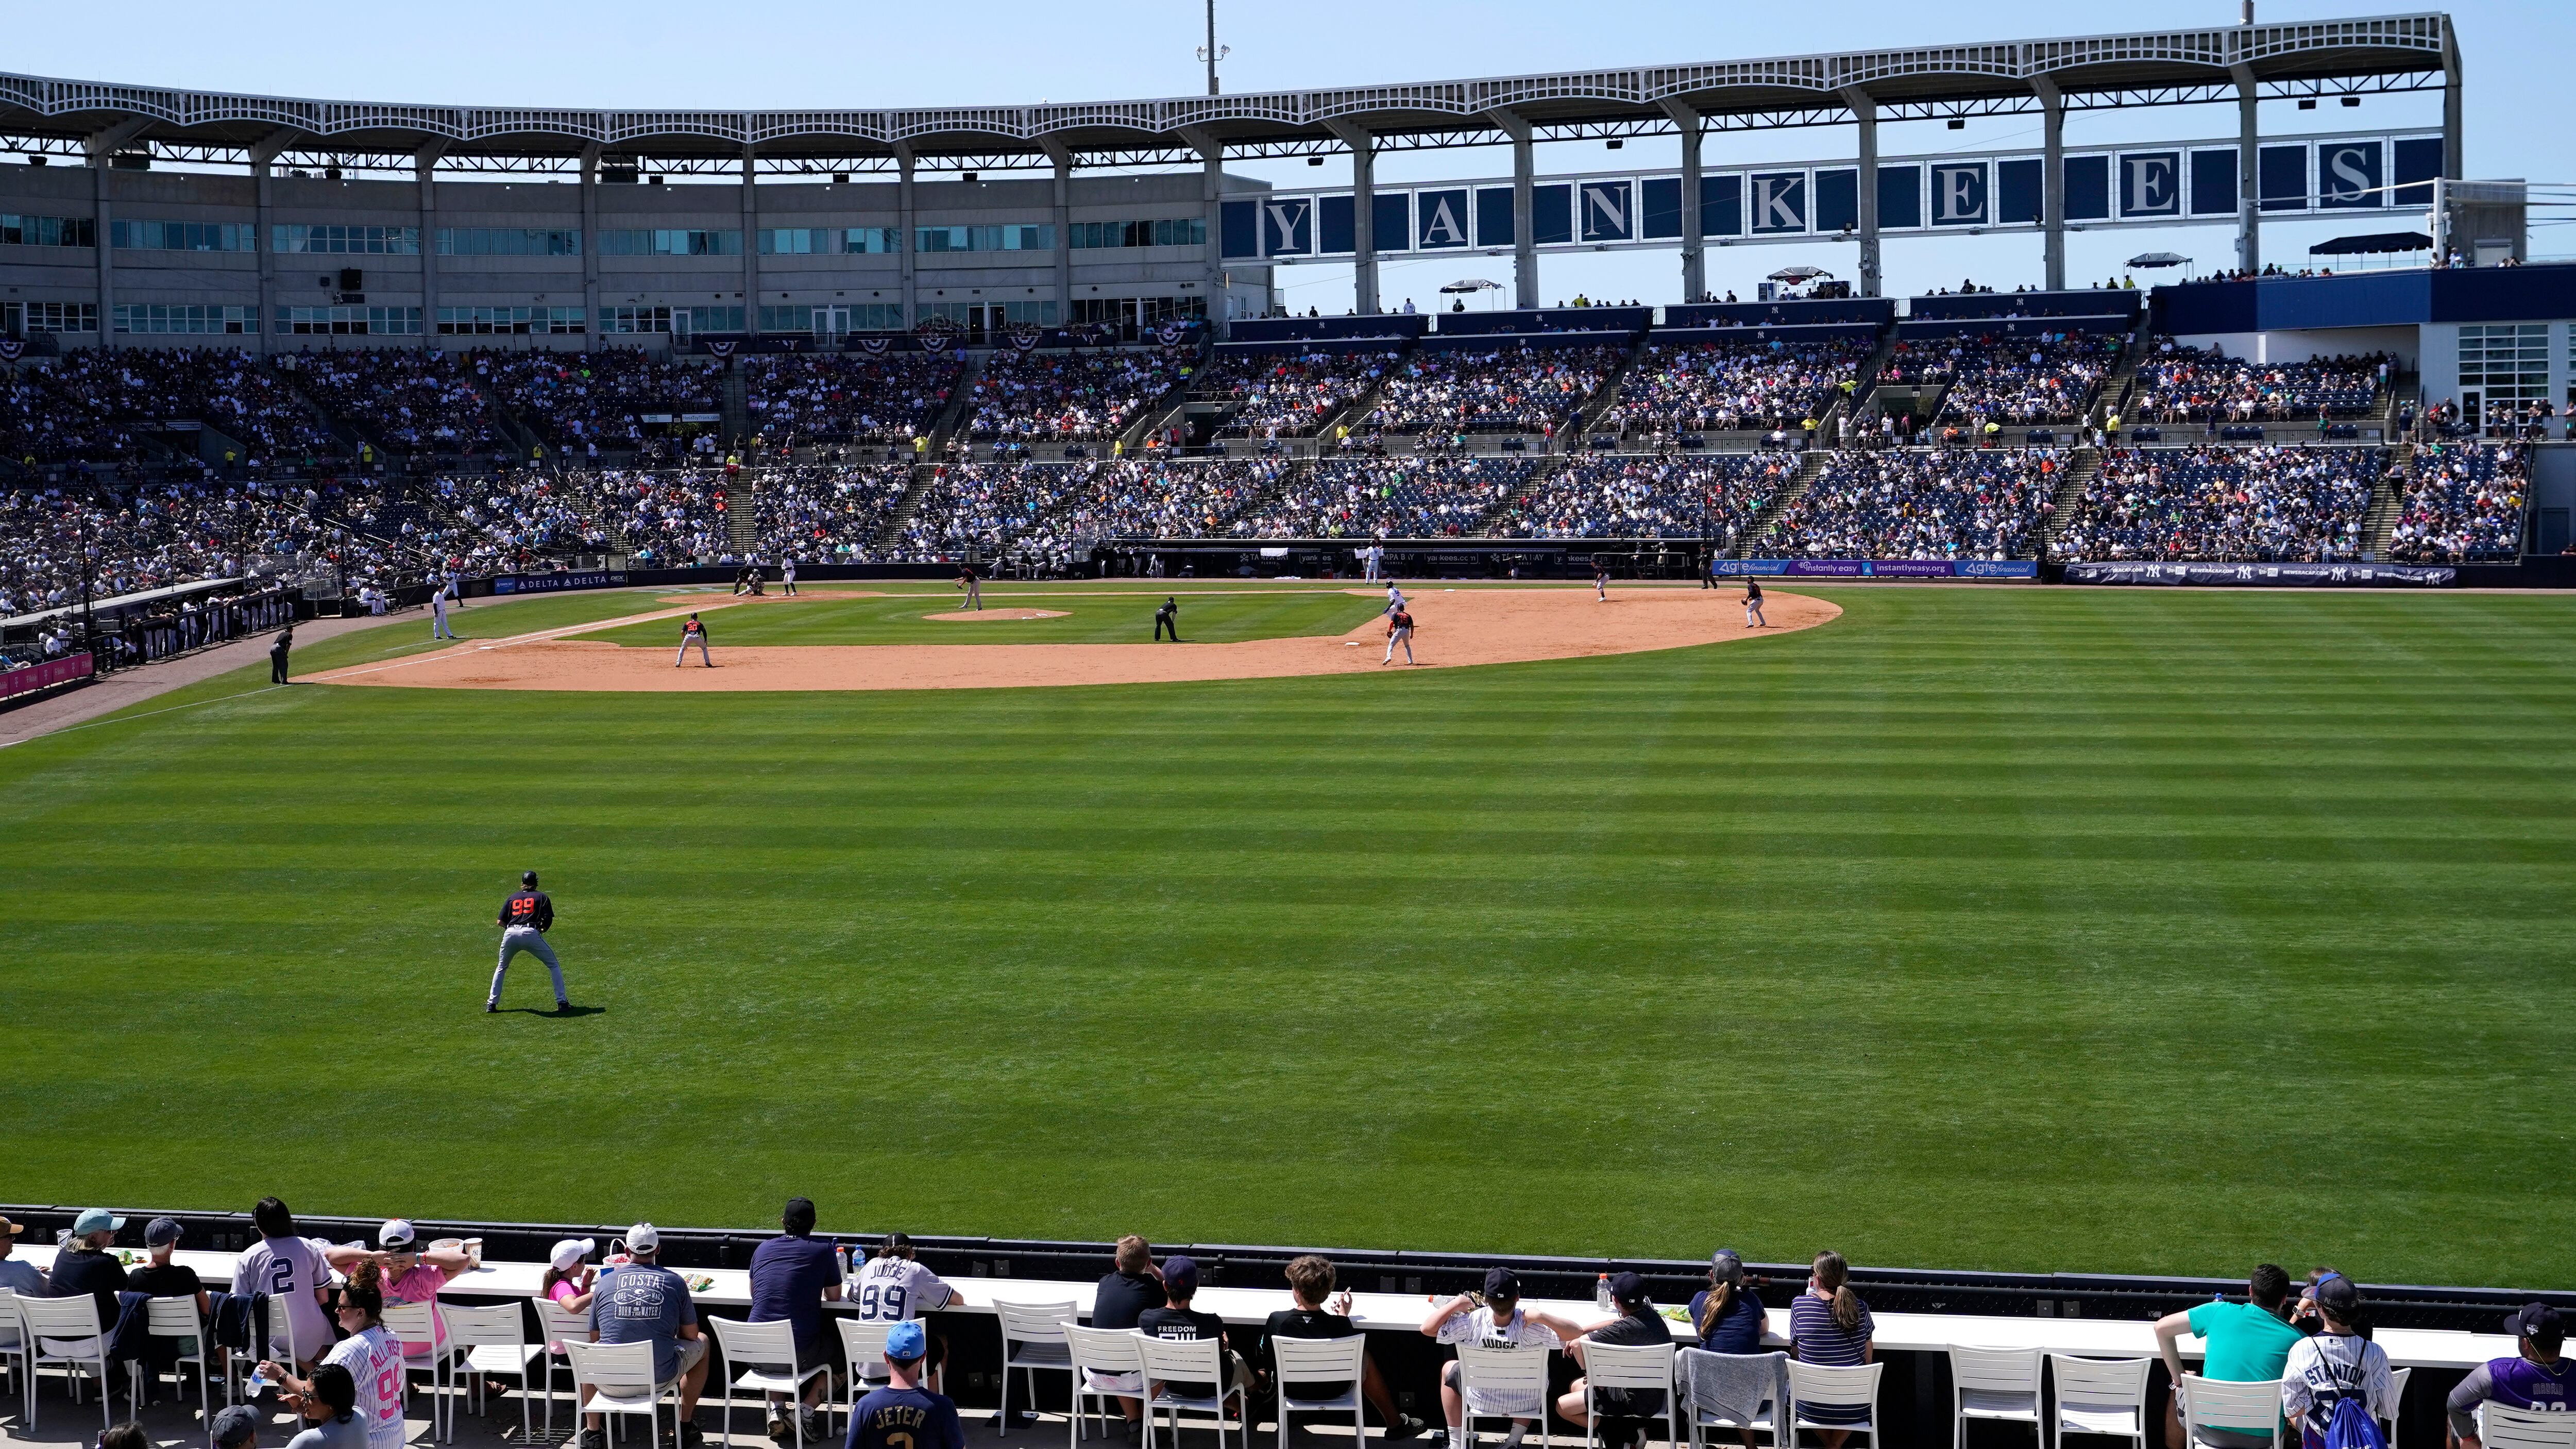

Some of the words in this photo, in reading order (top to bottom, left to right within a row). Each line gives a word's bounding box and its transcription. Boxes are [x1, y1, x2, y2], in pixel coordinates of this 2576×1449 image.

[1742, 563, 1780, 573] financial
[1806, 564, 1837, 573] instantly
[1877, 564, 1946, 573] instantlyeasy.org
[1976, 562, 1997, 575] gte
[1991, 564, 2030, 575] financial
[2146, 564, 2161, 578] NY
[2236, 565, 2252, 579] NY
[2331, 566, 2347, 581] NY
[528, 580, 559, 588] DELTA
[574, 576, 607, 585] DELTA
[512, 898, 535, 916] 99
[270, 1256, 296, 1294] 2
[871, 1260, 906, 1281] JUDGE
[621, 1274, 660, 1289] COSTA
[651, 1292, 661, 1301] MAR
[860, 1284, 908, 1322] 99
[2324, 1296, 2344, 1308] NHL
[618, 1306, 632, 1316] BORN
[641, 1306, 658, 1316] WATER
[370, 1345, 389, 1372] ALL
[2305, 1363, 2367, 1386] STANTON
[2532, 1383, 2564, 1396] MADRID
[876, 1406, 926, 1429] JETER
